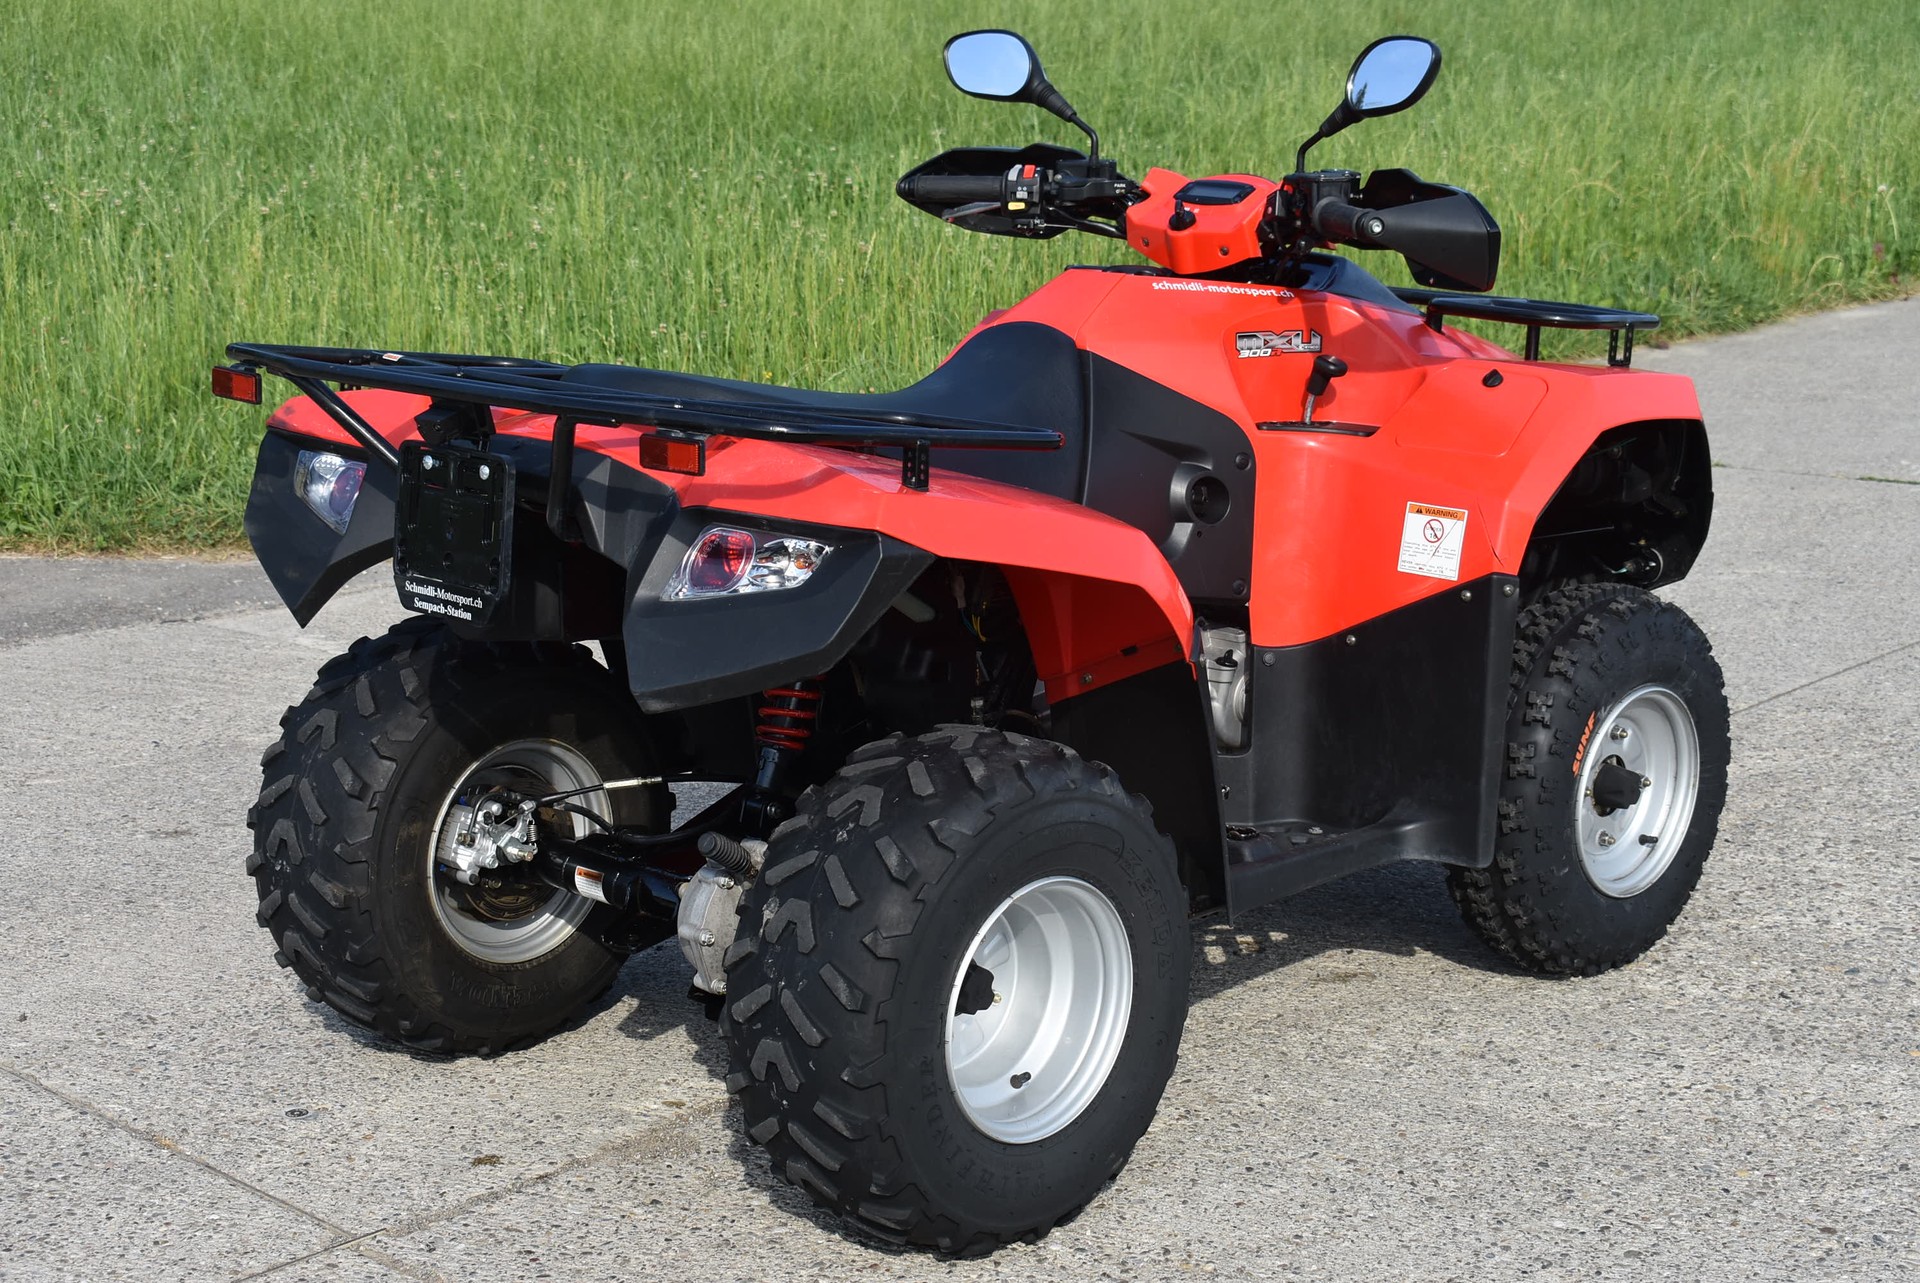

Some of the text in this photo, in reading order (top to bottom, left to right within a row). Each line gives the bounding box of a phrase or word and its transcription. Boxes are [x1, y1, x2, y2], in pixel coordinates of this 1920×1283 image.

[1152, 281, 1295, 298] schmidli-motorsport.ch
[1425, 508, 1458, 519] WARNING
[405, 581, 483, 609] Schmidli-Motorsport.ch
[413, 597, 472, 621] Sempach-Station
[1119, 848, 1175, 979] KENDA
